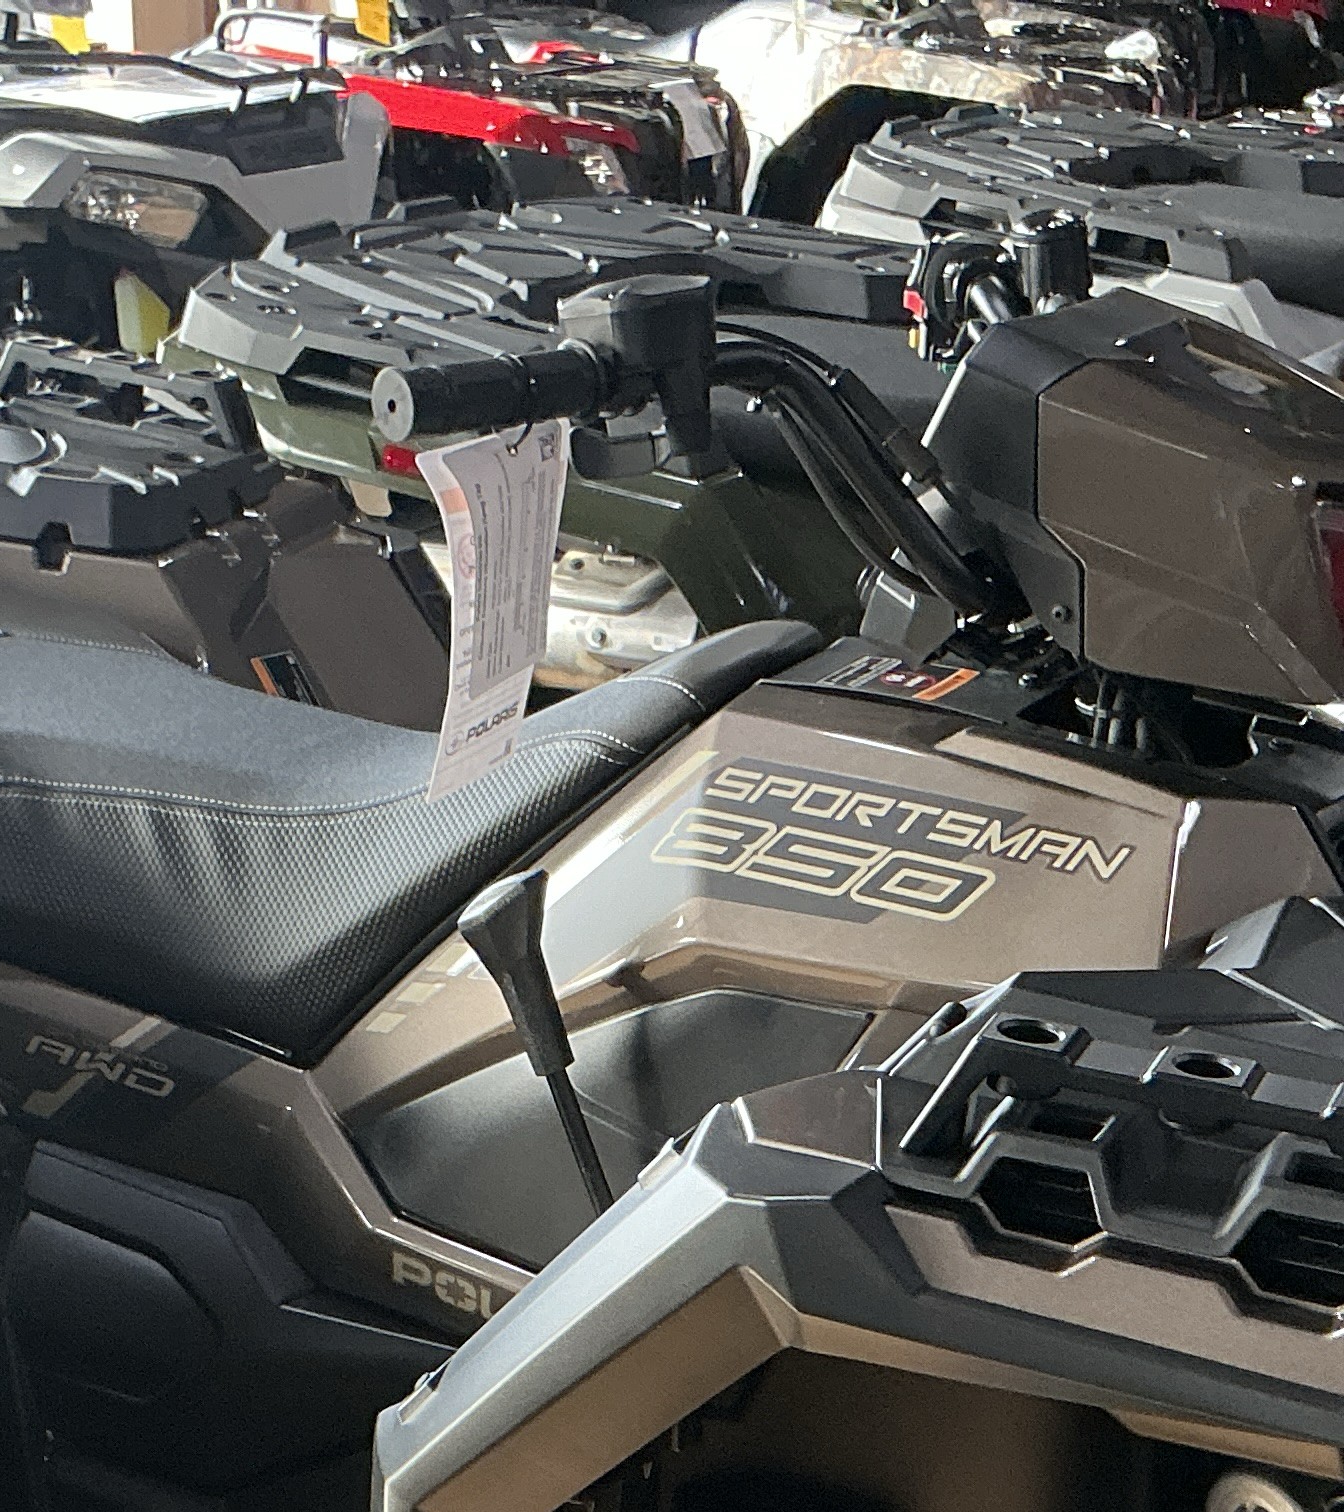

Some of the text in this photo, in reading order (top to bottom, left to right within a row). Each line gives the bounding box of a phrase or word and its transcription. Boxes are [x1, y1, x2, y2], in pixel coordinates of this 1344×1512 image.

[464, 701, 519, 742] POLARIS
[650, 806, 996, 922] 850
[704, 765, 1133, 881] SPORTSMAN
[25, 1035, 175, 1097] AWD
